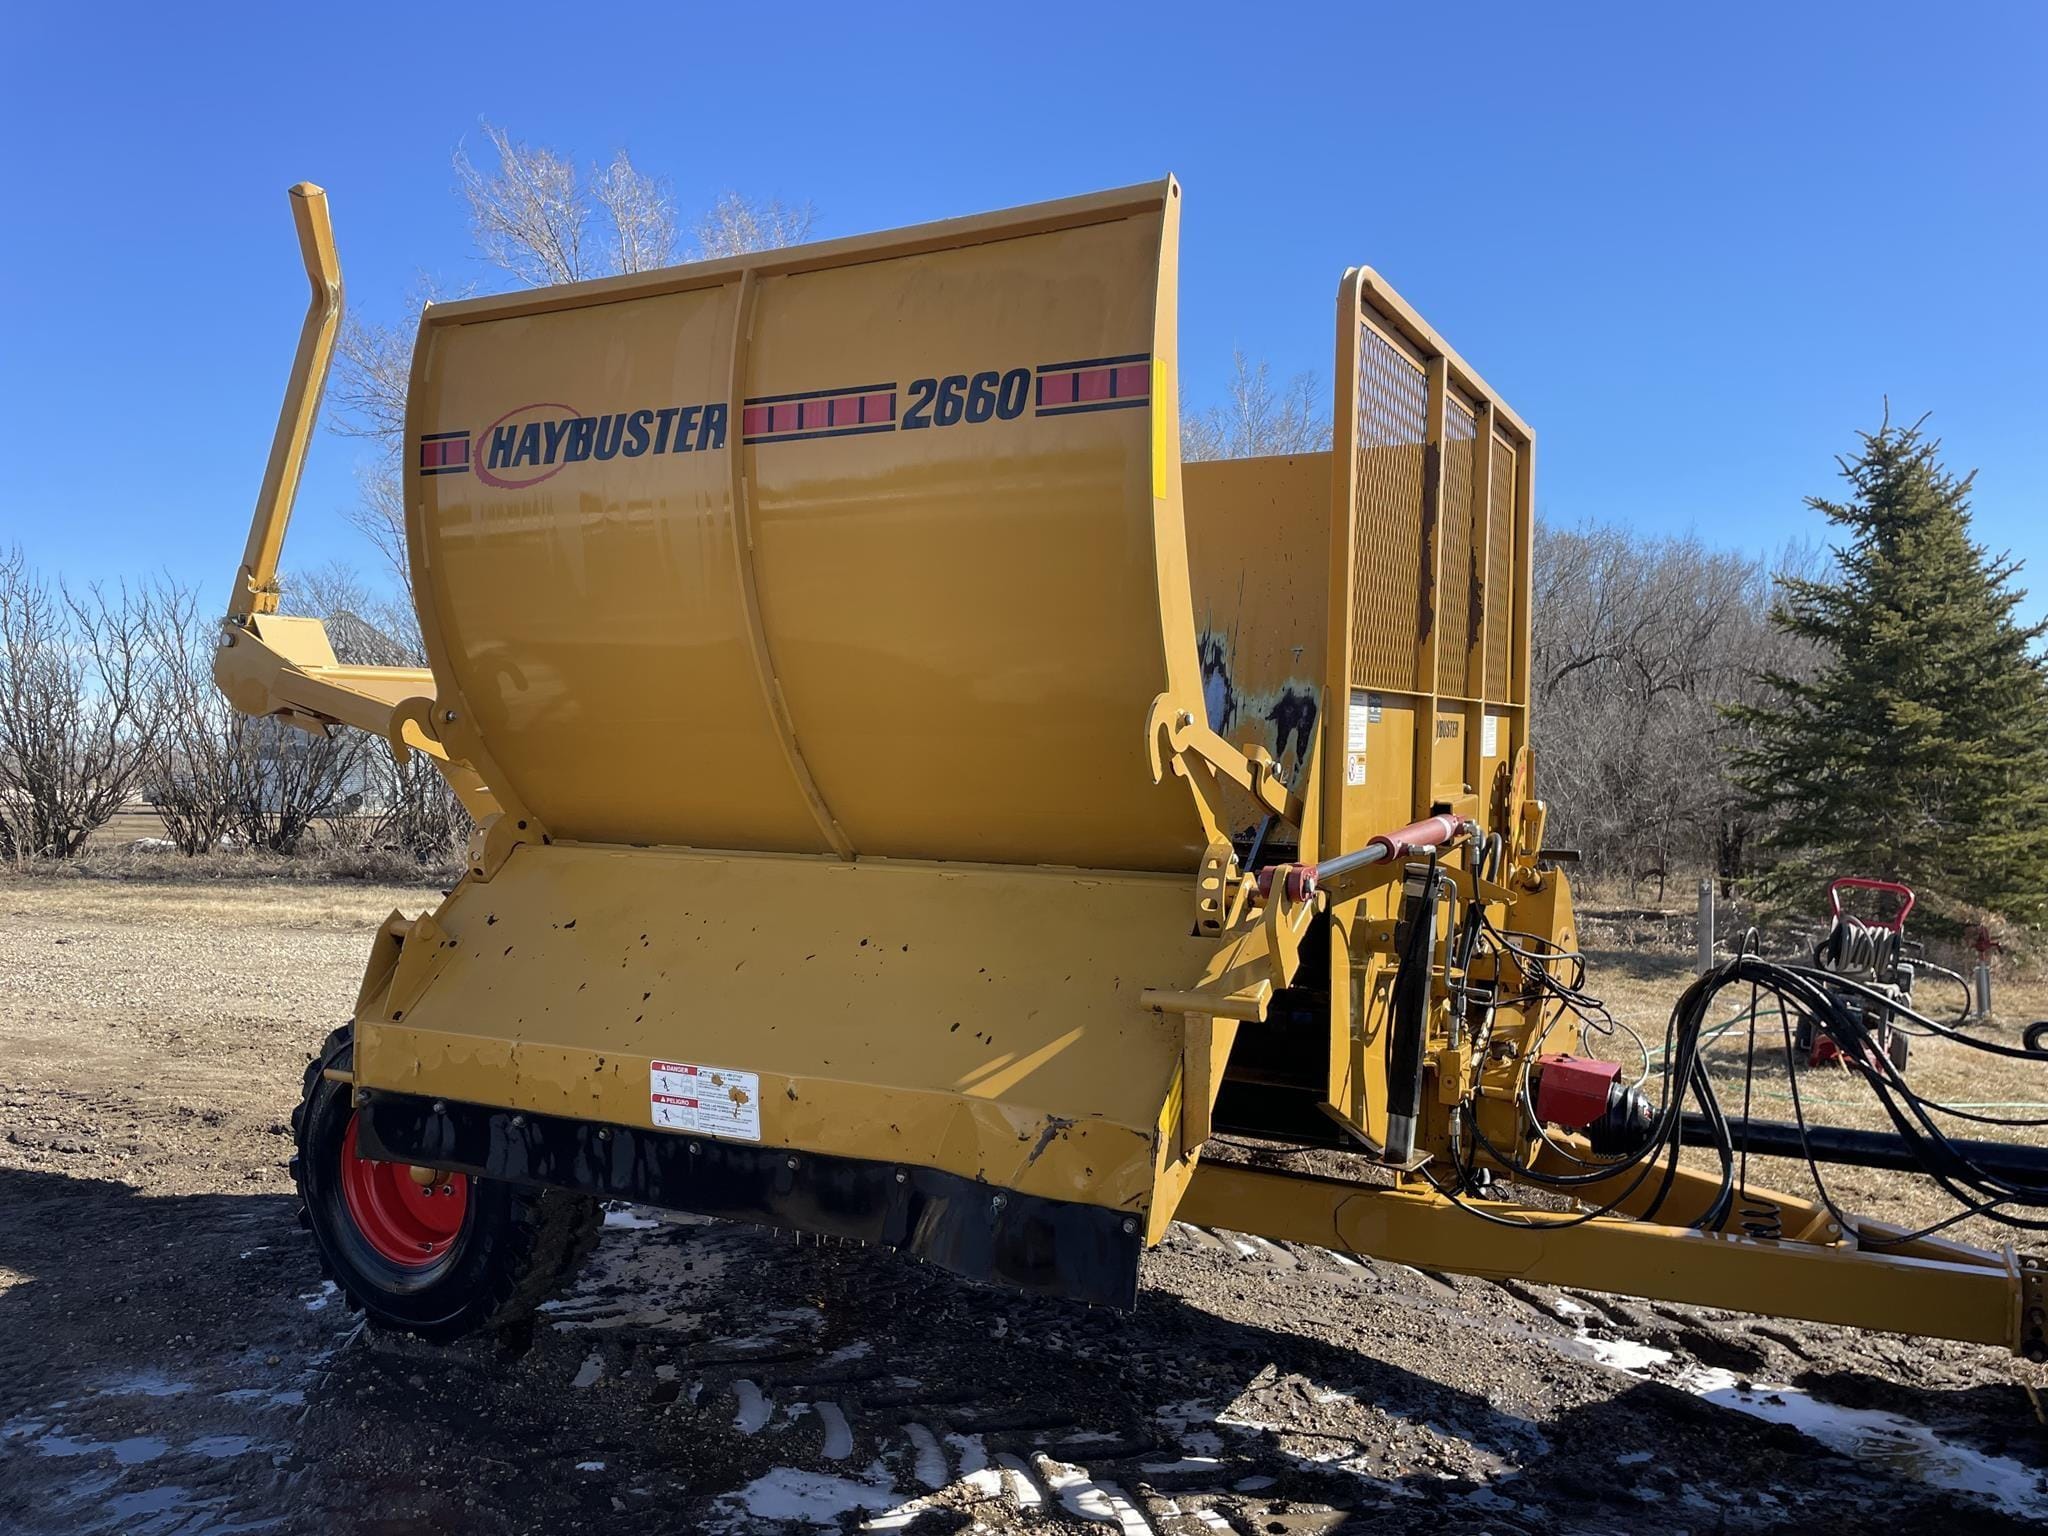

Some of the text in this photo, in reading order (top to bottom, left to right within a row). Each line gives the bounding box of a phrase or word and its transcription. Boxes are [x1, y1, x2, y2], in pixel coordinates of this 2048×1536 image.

[900, 368, 1031, 430] 2660
[487, 402, 728, 469] HAYBUSTER
[1436, 719, 1459, 738] YBUSTER
[666, 1065, 689, 1073] DANGER
[666, 1097, 689, 1106] PELIGRO
